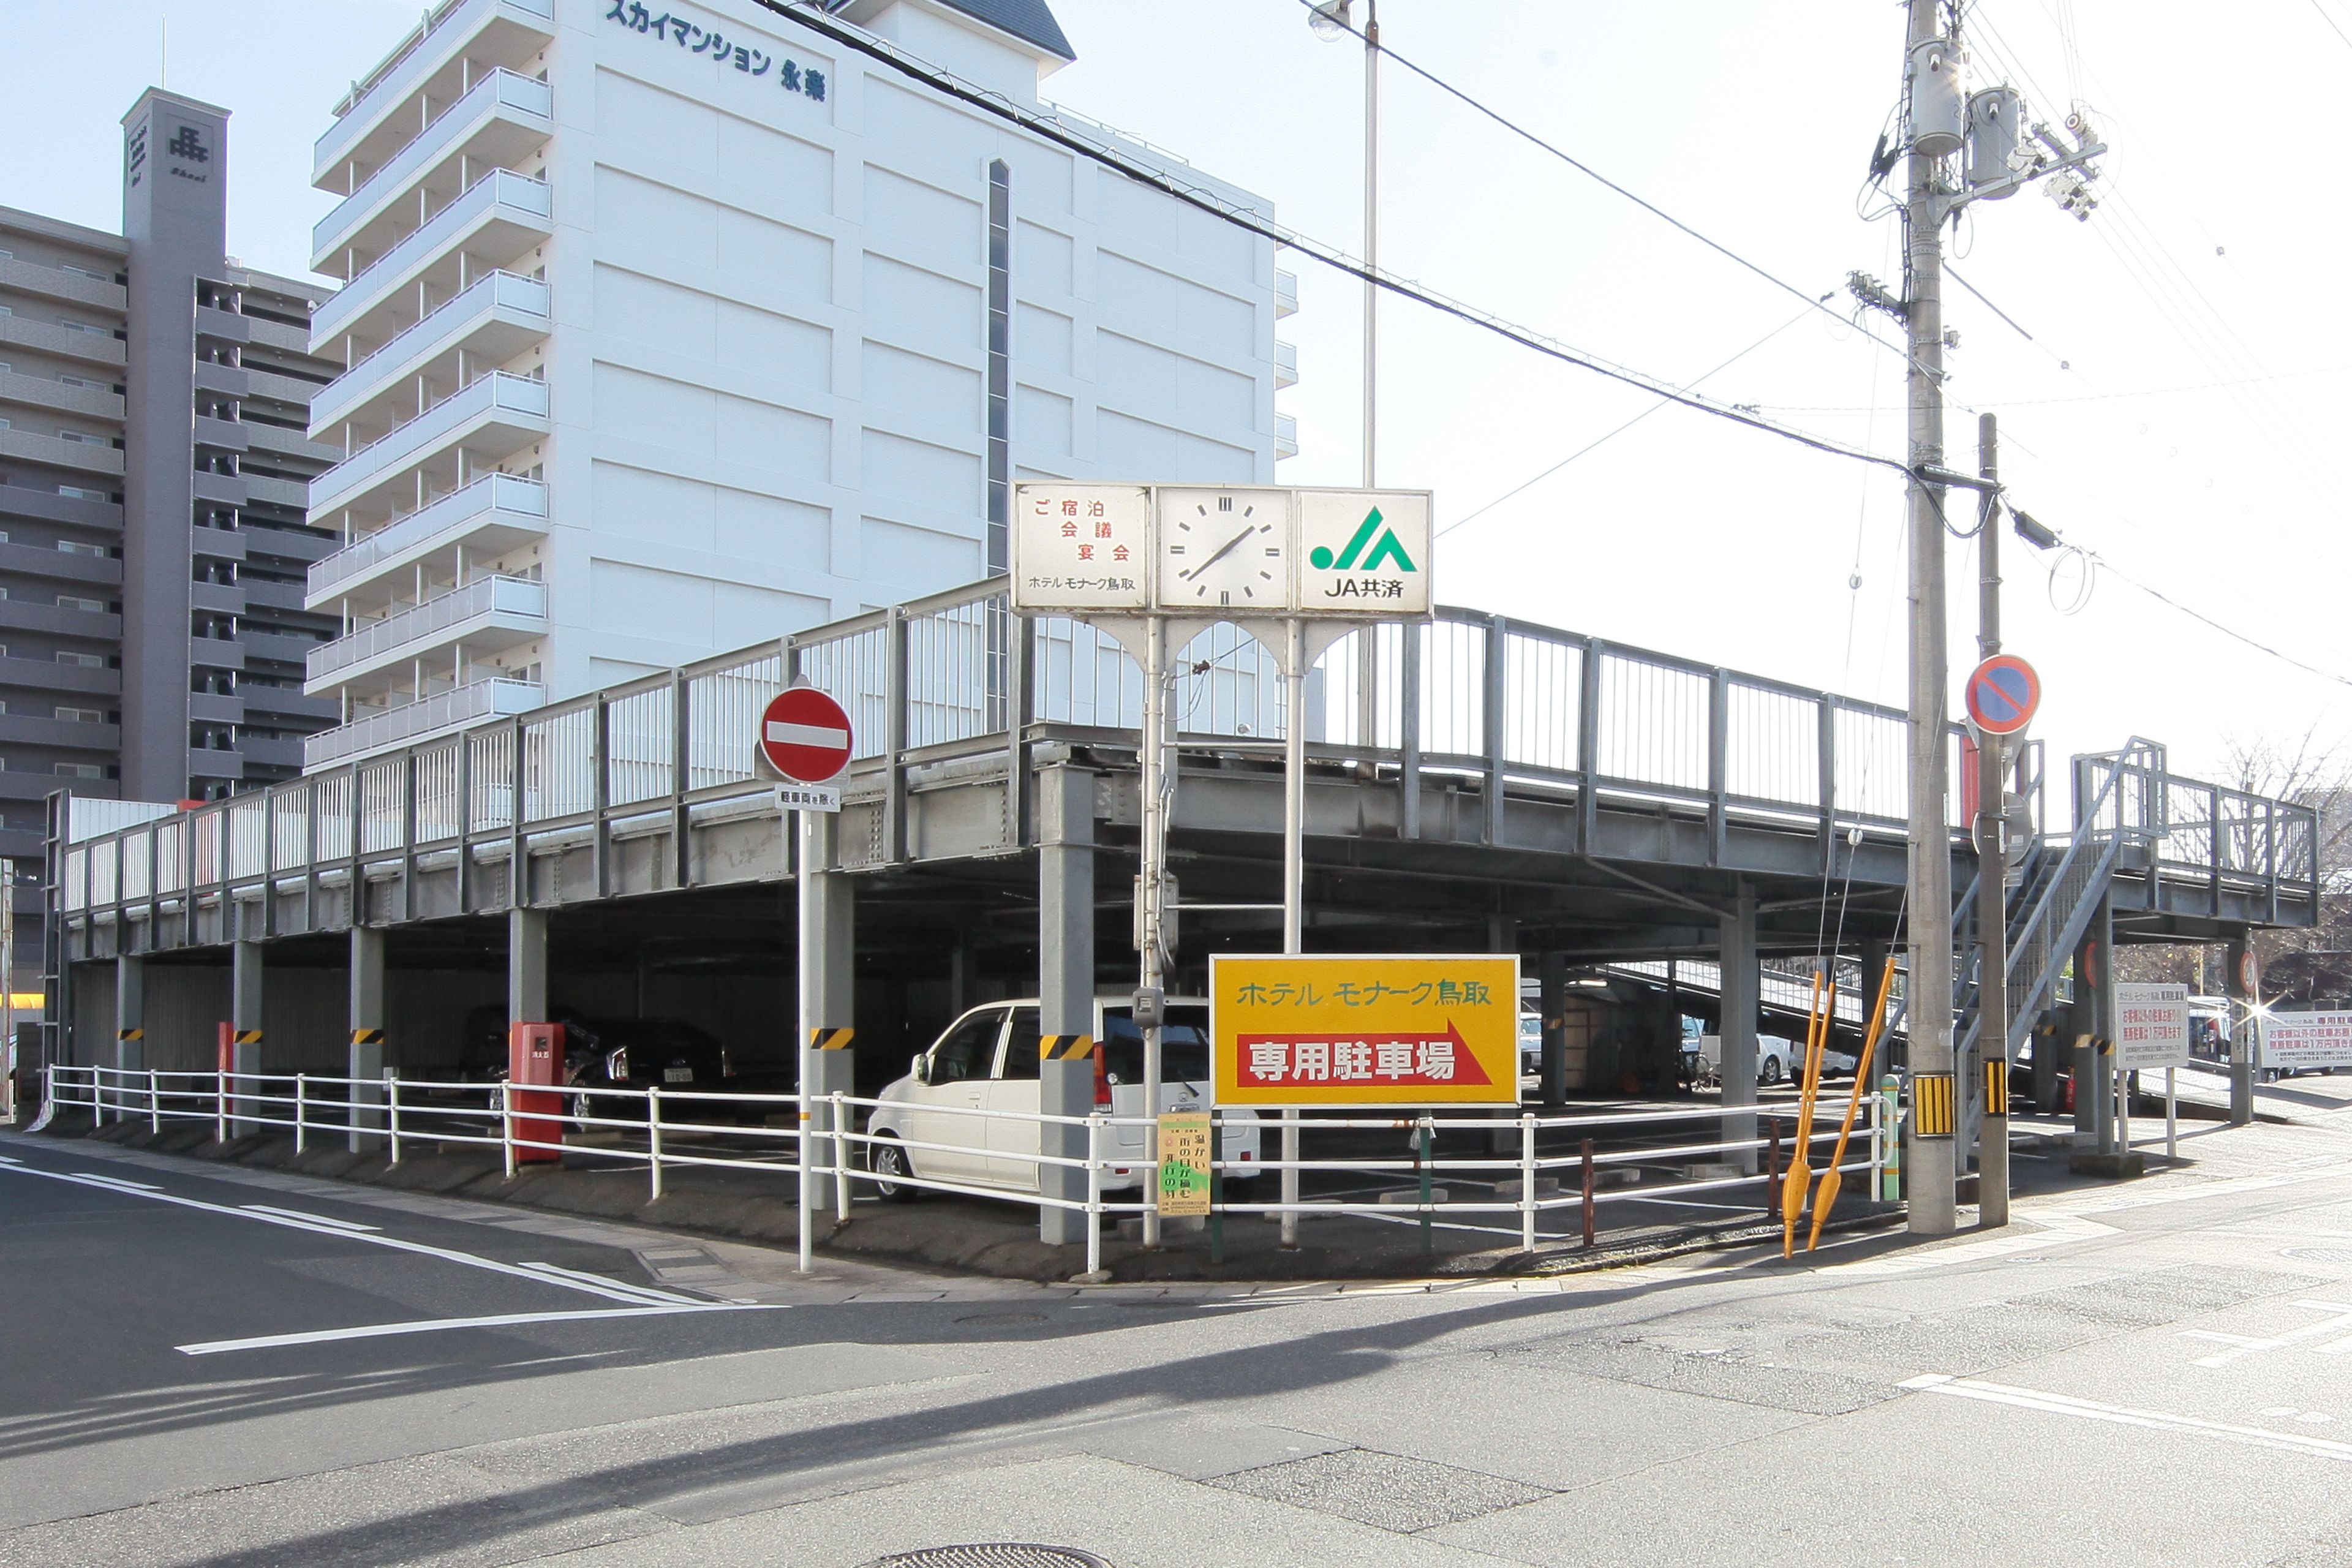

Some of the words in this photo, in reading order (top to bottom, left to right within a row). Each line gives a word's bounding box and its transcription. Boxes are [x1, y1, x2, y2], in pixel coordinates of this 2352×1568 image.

[606, 0, 771, 76] スカイマンション
[1035, 499, 1104, 517] ご宿泊
[1060, 521, 1112, 539] 会議
[1078, 544, 1129, 562] 宴会
[1324, 578, 1404, 598] JA共済
[780, 791, 835, 807] 軽車両を除く
[1237, 982, 1324, 1006] ホテル
[1333, 978, 1493, 1006] モナーク鳥取
[2269, 1028, 2352, 1038] お客様以外の駐車お断
[1248, 1040, 1455, 1082] 専用駐車場
